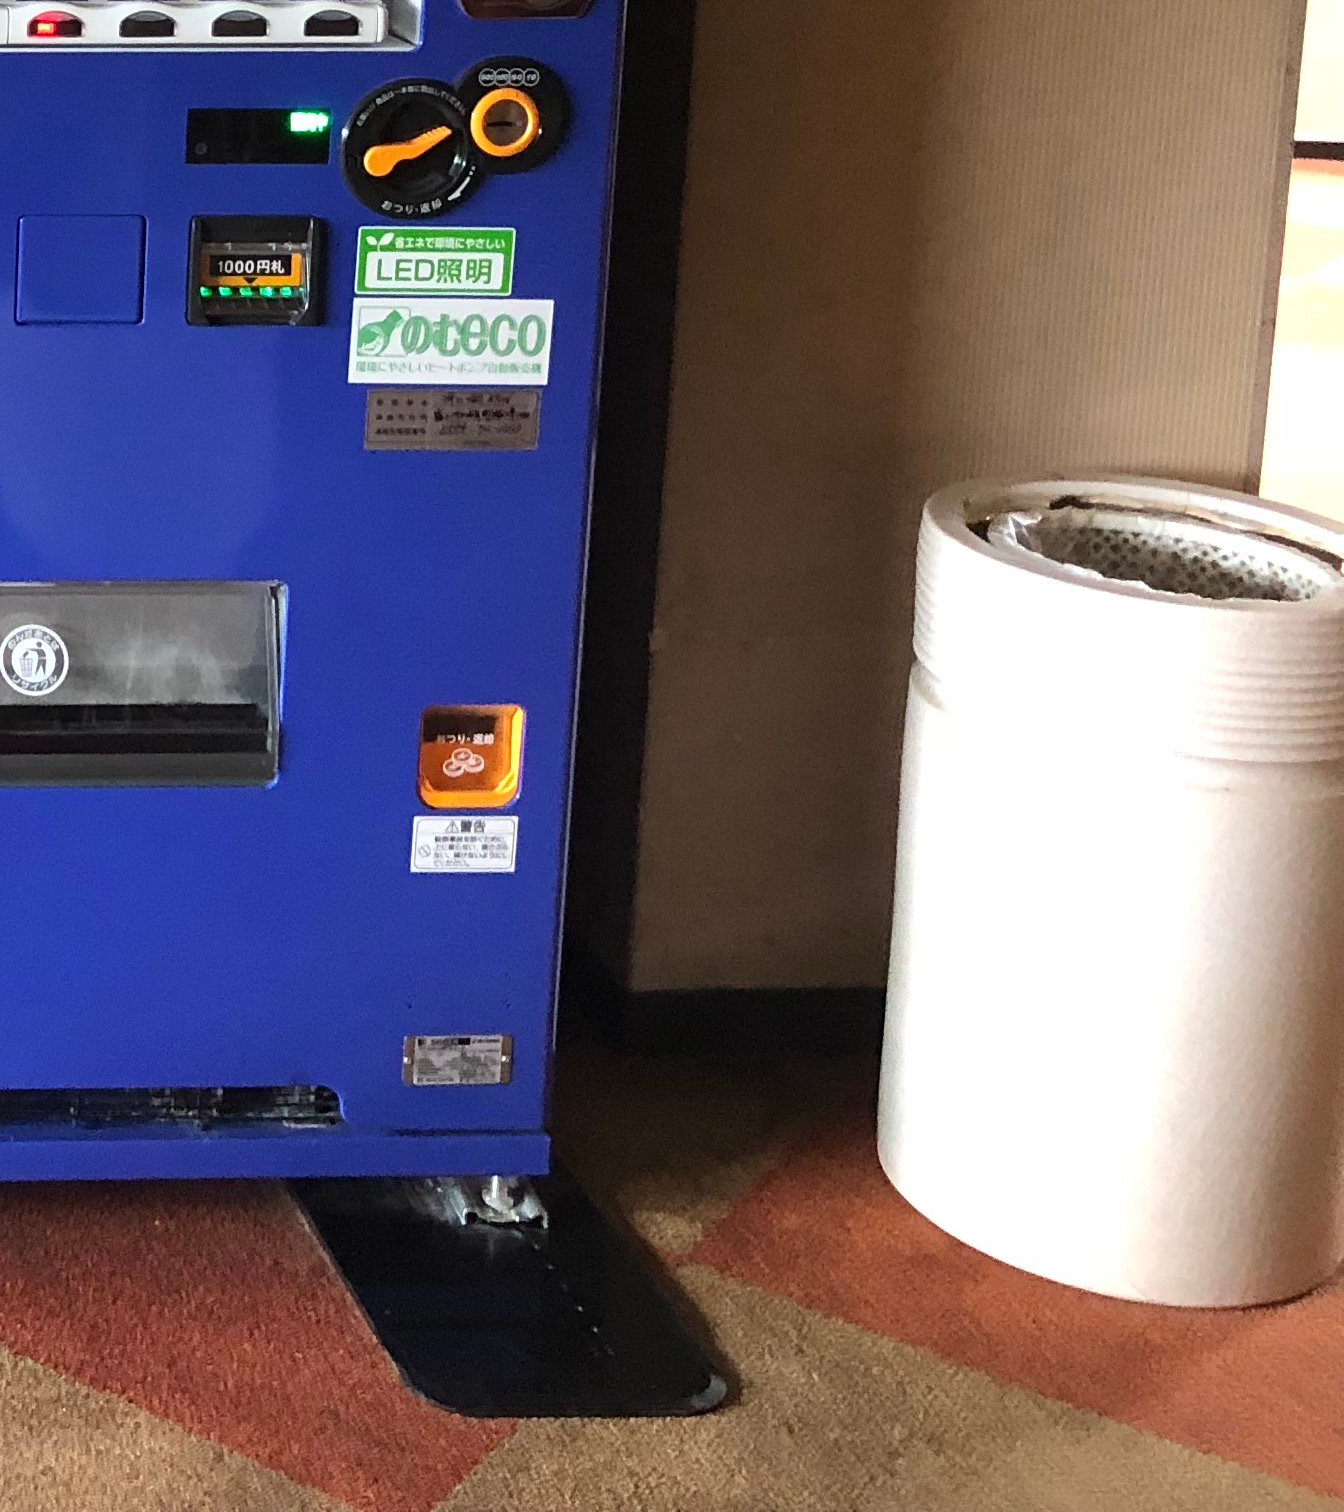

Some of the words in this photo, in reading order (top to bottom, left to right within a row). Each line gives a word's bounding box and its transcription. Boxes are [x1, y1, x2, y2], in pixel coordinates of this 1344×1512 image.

[395, 237, 506, 250] 省エネで環境にやさしい
[217, 259, 286, 275] 1000円札
[376, 258, 493, 285] LED照明
[400, 313, 547, 358] のむeco
